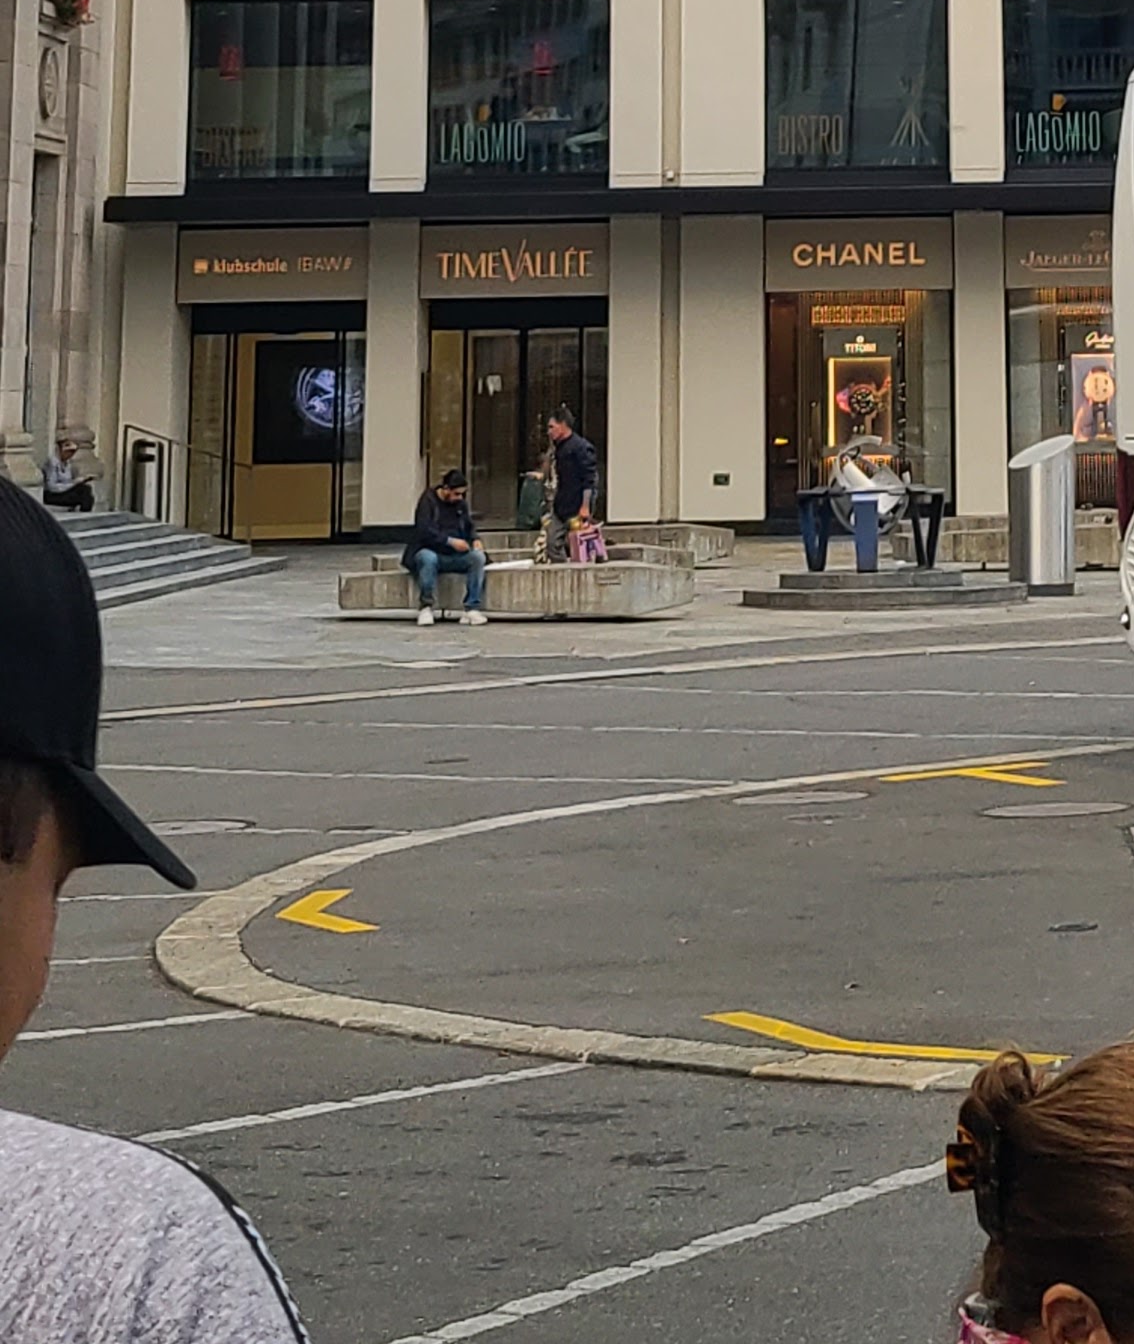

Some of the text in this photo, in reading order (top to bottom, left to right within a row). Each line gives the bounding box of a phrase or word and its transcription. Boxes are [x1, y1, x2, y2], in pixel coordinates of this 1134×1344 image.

[778, 114, 844, 155] BISTRO
[1015, 110, 1101, 153] LAGOMIO
[213, 257, 288, 273] klubschule
[792, 241, 926, 267] CHANEL
